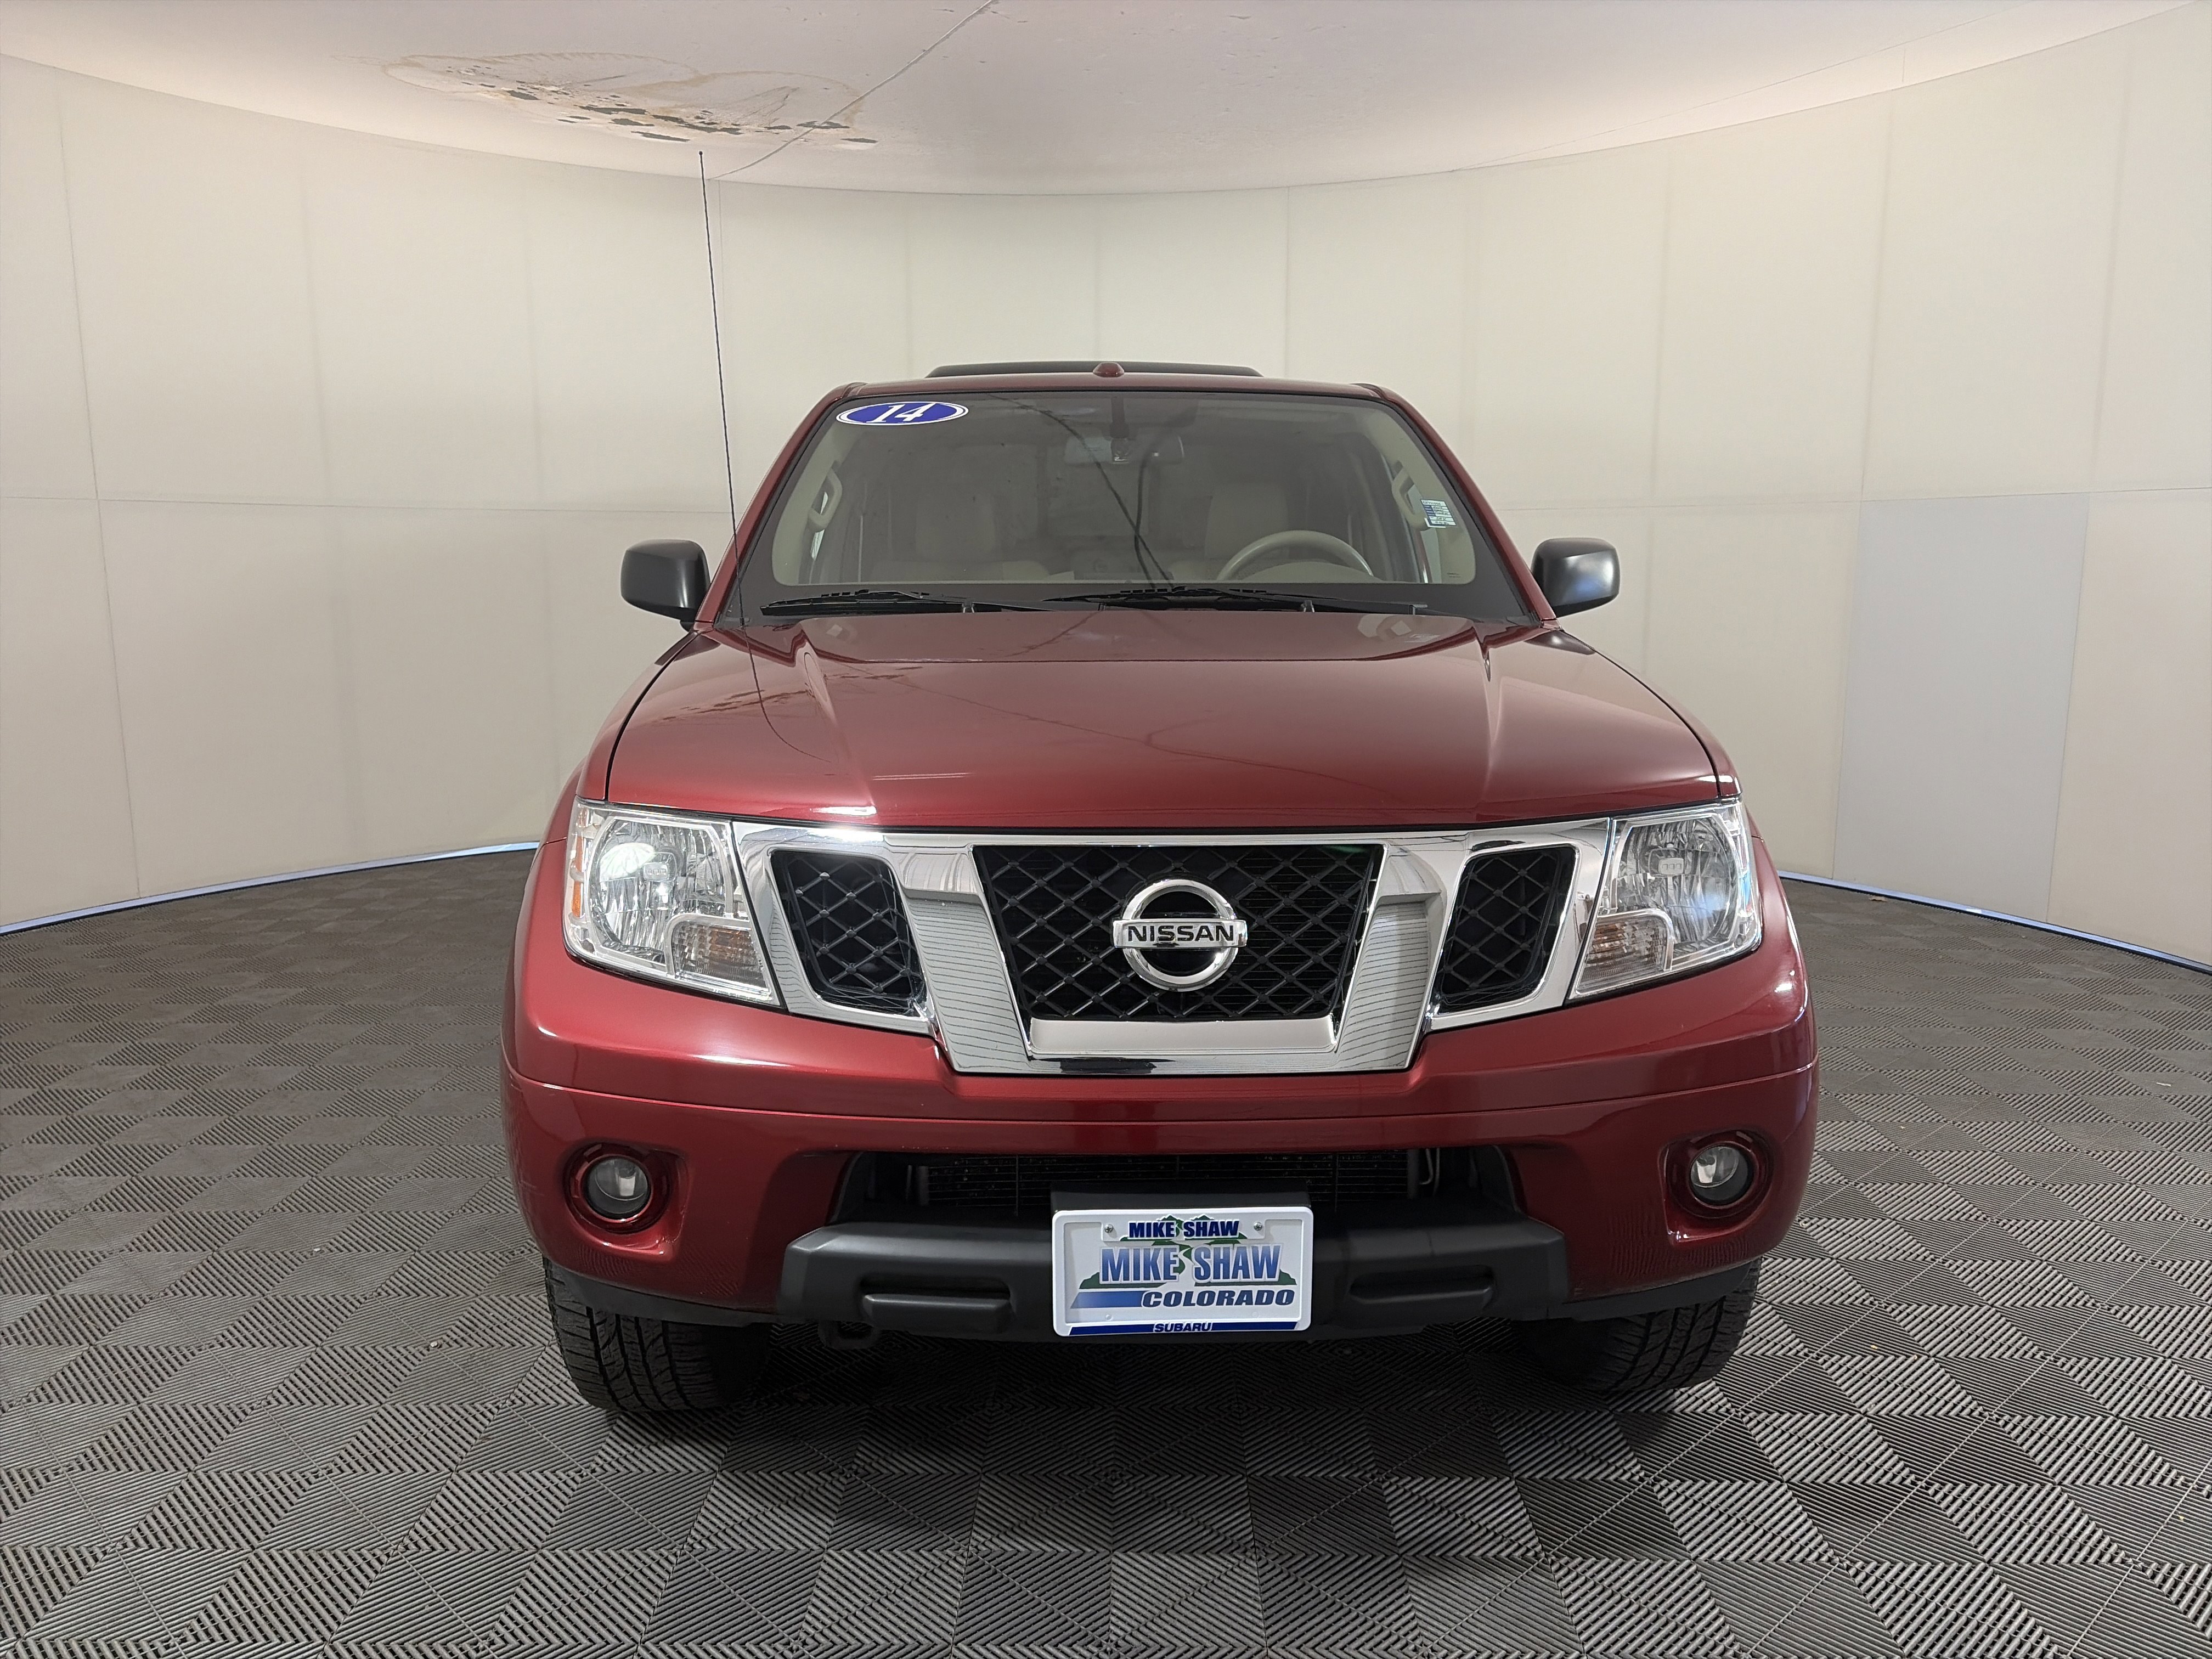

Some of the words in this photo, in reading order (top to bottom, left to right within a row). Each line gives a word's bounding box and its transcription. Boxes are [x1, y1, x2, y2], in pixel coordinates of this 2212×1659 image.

[866, 403, 936, 423] 14
[1127, 925, 1234, 942] NISSAN
[1128, 1221, 1175, 1238] MIKE
[1184, 1220, 1239, 1237] SHAW
[1101, 1246, 1178, 1282] MIKE
[1194, 1245, 1281, 1280] SHAW
[1142, 1289, 1295, 1308] COLORADO
[1154, 1322, 1211, 1332] SUBARU
